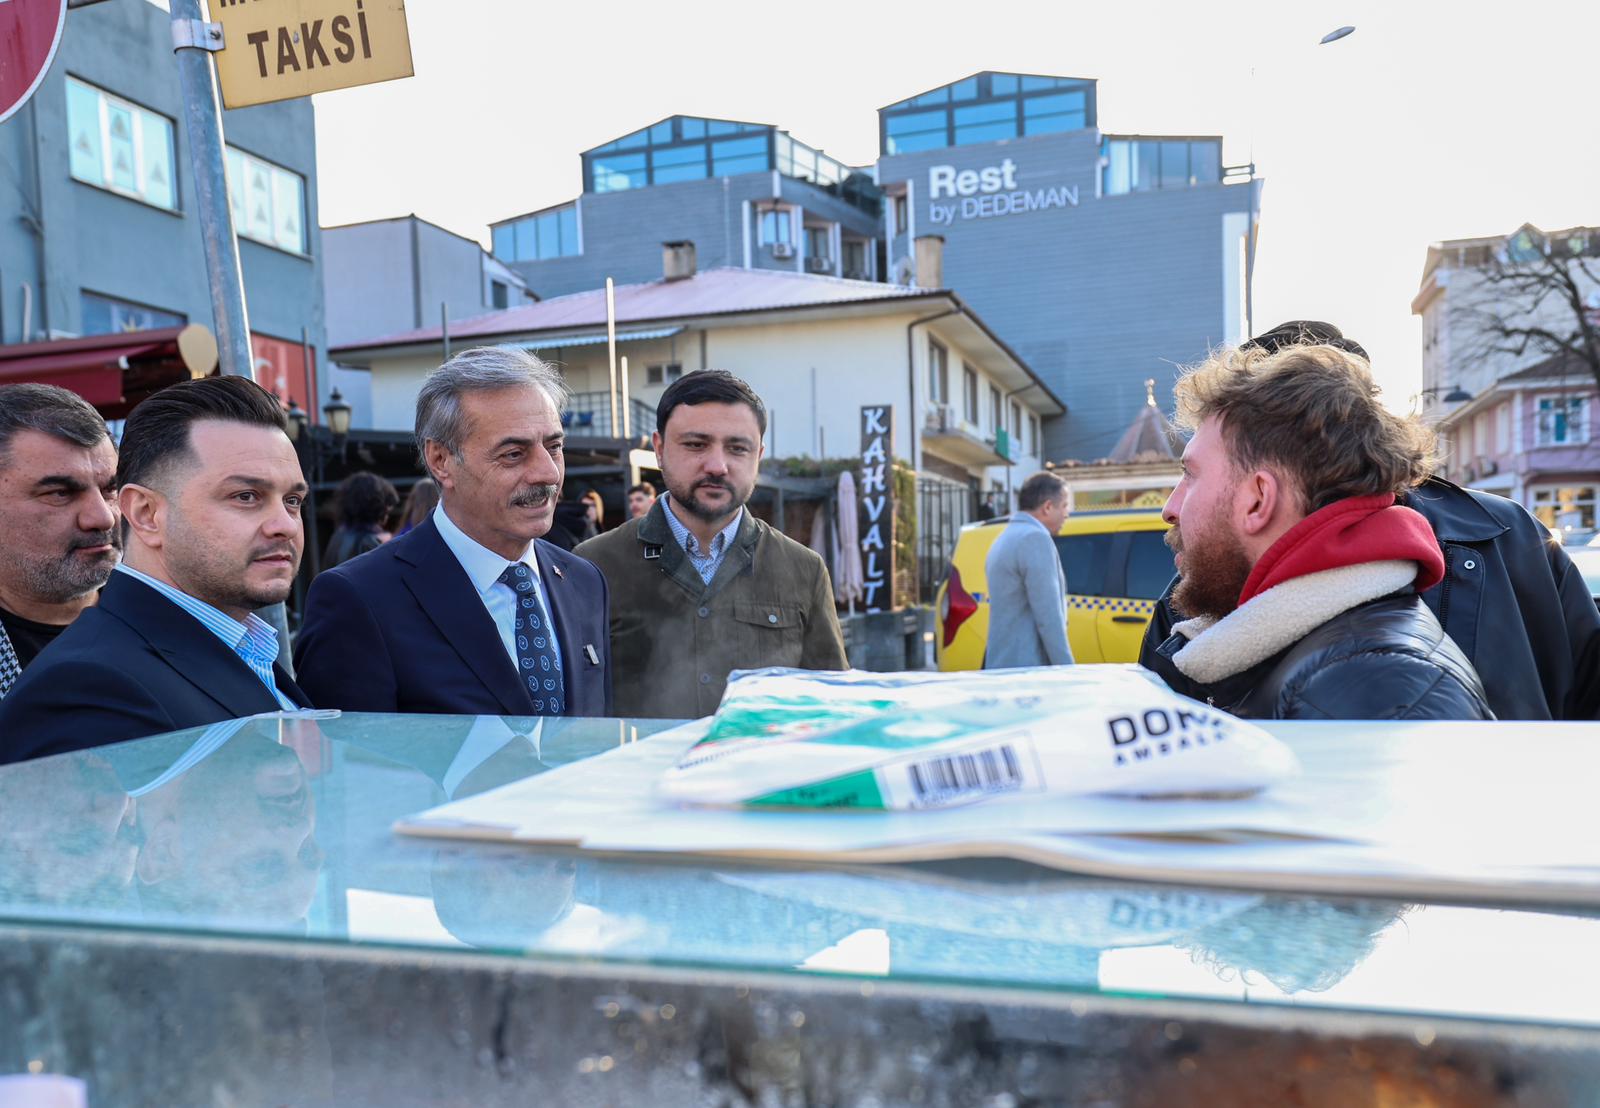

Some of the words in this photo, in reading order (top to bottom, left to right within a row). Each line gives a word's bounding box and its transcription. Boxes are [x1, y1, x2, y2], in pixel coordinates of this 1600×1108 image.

[247, 0, 372, 78] TAKSİ
[928, 158, 1018, 199] Rest
[929, 202, 956, 225] by
[961, 185, 1080, 220] DEDEMAN
[862, 407, 888, 615] KAHVALT
